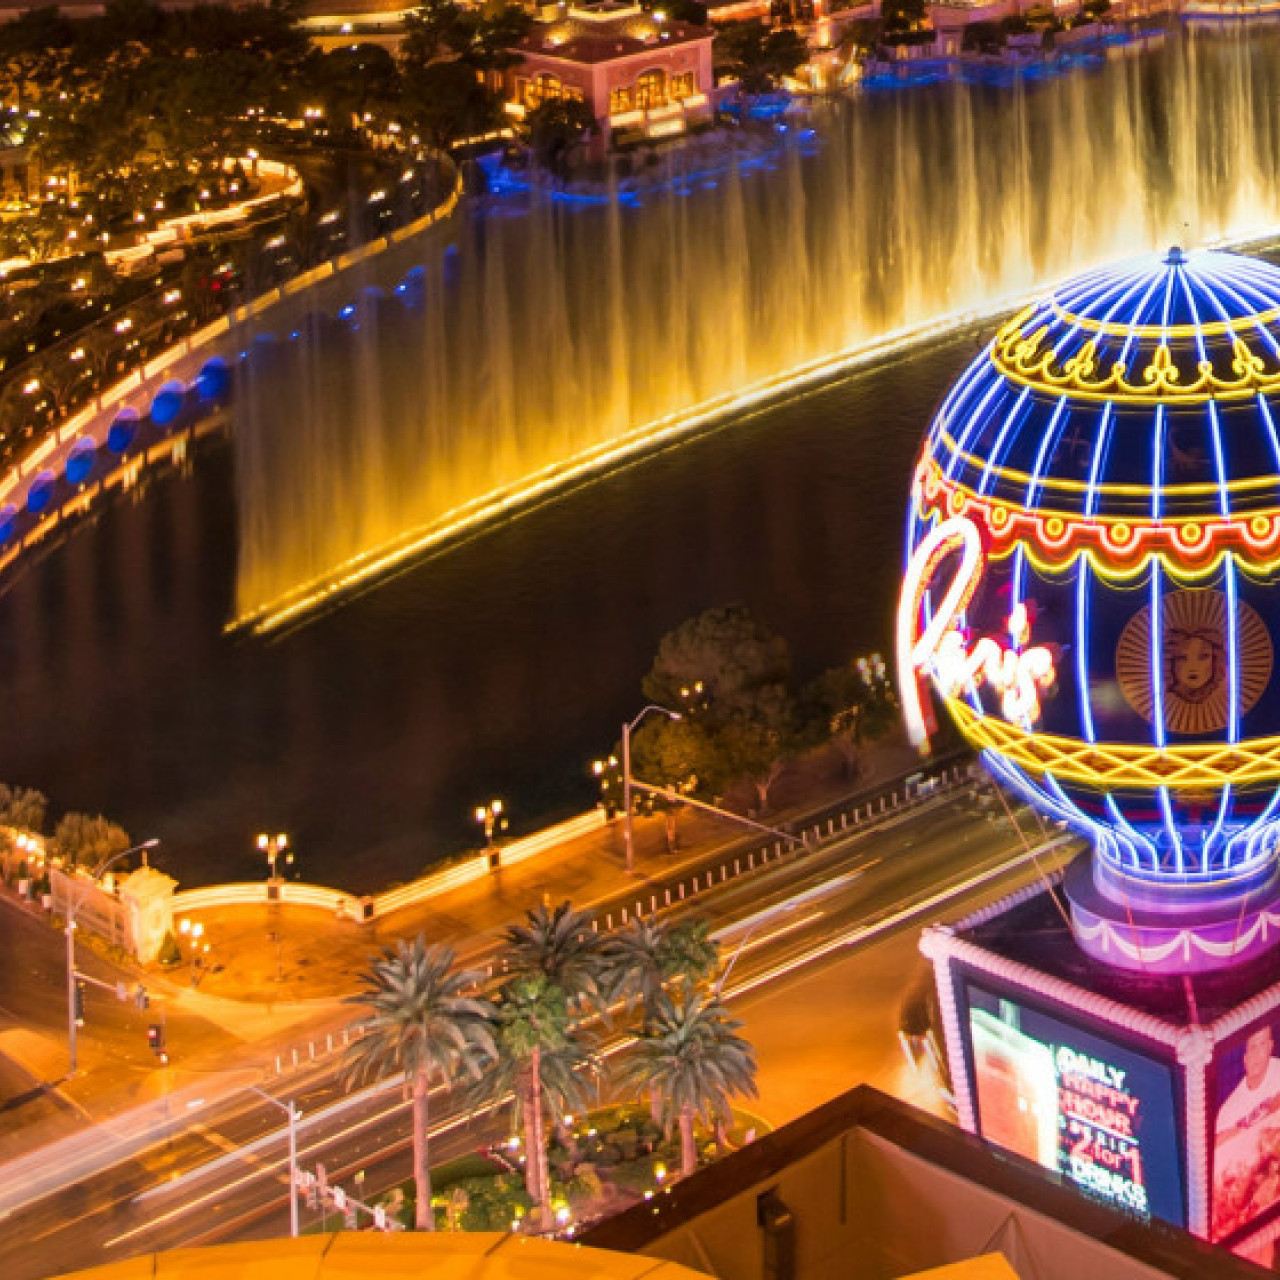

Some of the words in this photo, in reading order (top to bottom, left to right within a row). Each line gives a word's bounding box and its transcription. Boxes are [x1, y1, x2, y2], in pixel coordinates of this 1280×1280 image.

[896, 515, 1057, 752] Paris
[1056, 1045, 1126, 1090] DAILY
[1058, 1088, 1131, 1137] HOUR
[1061, 1072, 1140, 1117] HAPPY
[1067, 1119, 1093, 1164] 2
[1121, 1145, 1143, 1186] 1
[1068, 1157, 1149, 1213] DRINKS
